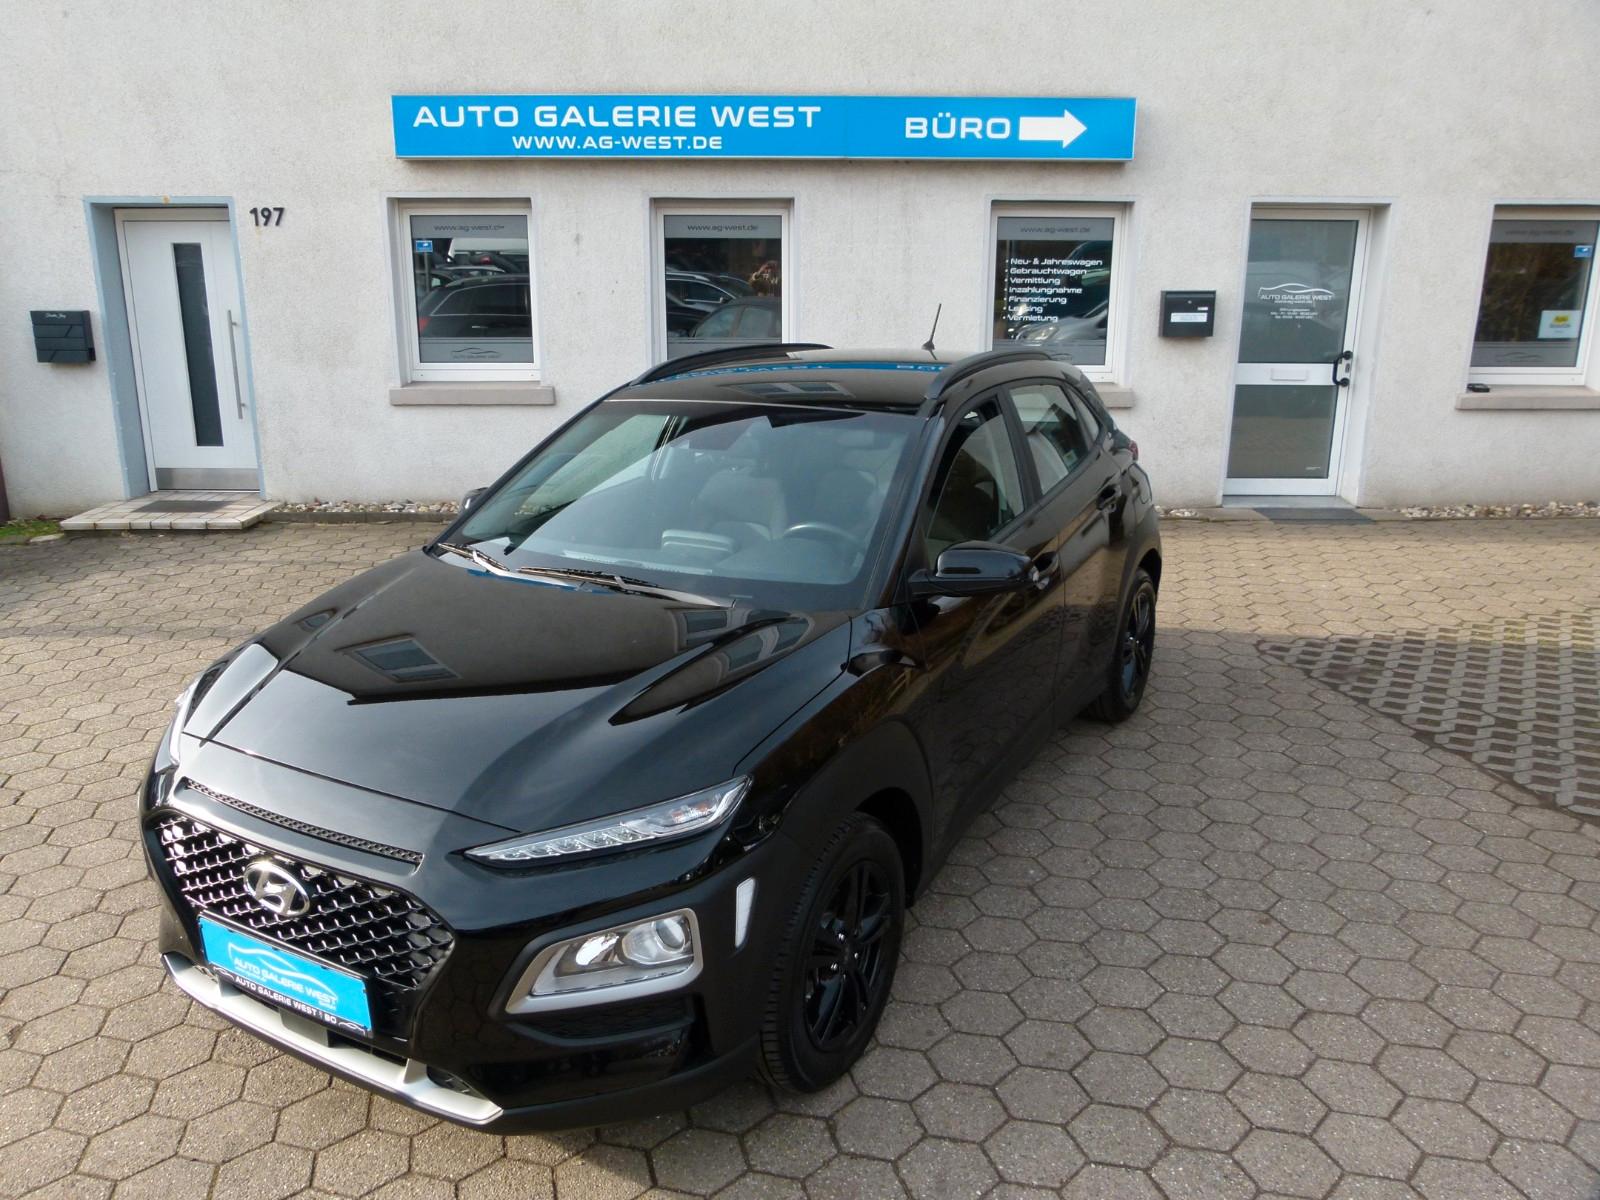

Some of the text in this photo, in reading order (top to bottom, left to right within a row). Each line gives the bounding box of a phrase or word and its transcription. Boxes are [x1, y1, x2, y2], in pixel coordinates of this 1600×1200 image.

[413, 106, 822, 128] AUTO GALERIE WEST
[905, 112, 1012, 139] BÜRO
[512, 136, 723, 150] WWW.AG-WEST.DE
[249, 207, 285, 226] 197
[1041, 258, 1103, 266] Jahreswagen
[1010, 267, 1087, 276] Gebrauchtwagen
[1010, 277, 1061, 285] Vermittlung
[1009, 287, 1083, 295] Inzahlungnahme
[1008, 296, 1067, 304] Finanzierung
[1007, 315, 1058, 323] Vermietung
[235, 958, 259, 974] AUTO
[305, 987, 337, 1004] WEST
[235, 976, 256, 990] AUTO
[293, 1001, 318, 1016] WEST
